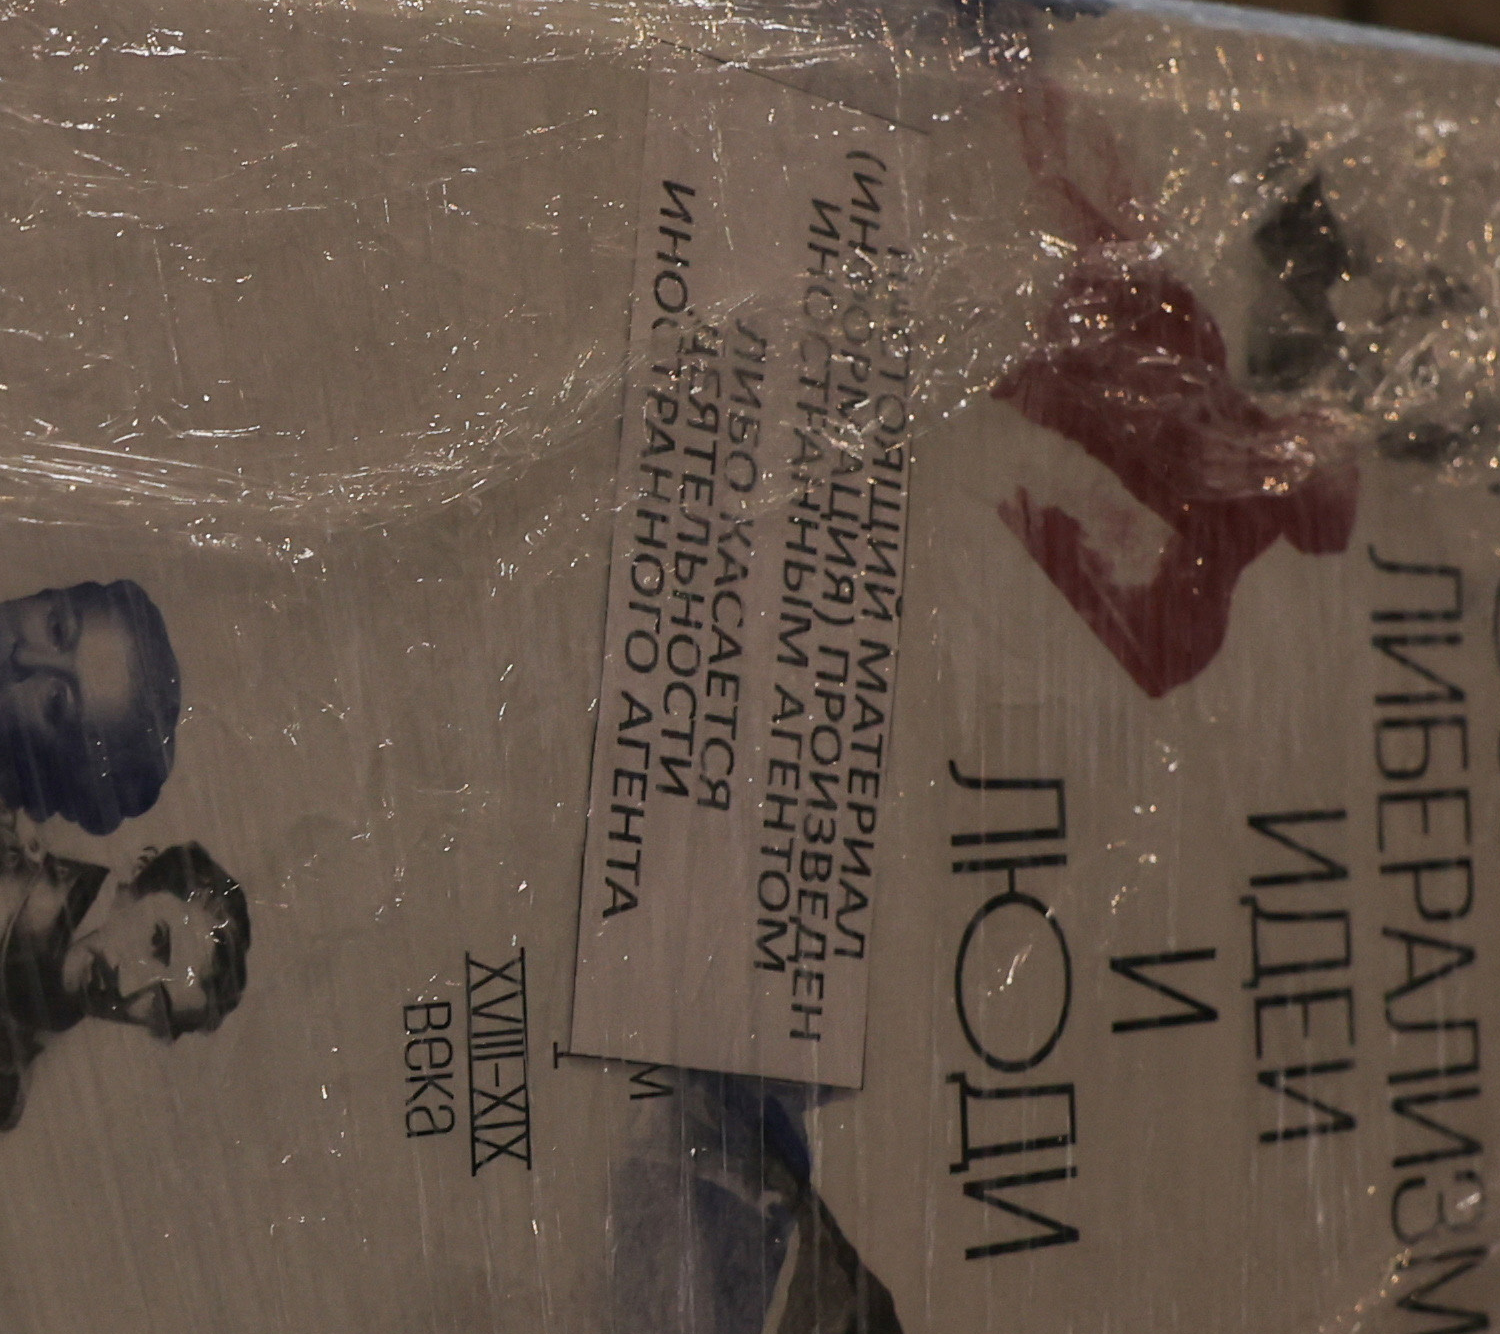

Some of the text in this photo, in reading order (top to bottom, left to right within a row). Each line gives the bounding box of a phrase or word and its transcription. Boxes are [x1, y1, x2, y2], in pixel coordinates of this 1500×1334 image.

[696, 319, 768, 812] ЛИБО КАСАЕТСЯ
[752, 198, 842, 973] ИНОСТРАННЫМ АГЕНТОМ
[601, 691, 653, 920] АГЕНТА
[787, 646, 848, 1042] ПРОИЗВЕДЕН
[833, 639, 890, 960] МАТЕРИАЛ
[401, 1000, 455, 1139] века
[945, 760, 1079, 1261] ЛЮДИ
[1109, 948, 1218, 1033] И
[1240, 809, 1356, 1145] ИДЕИ
